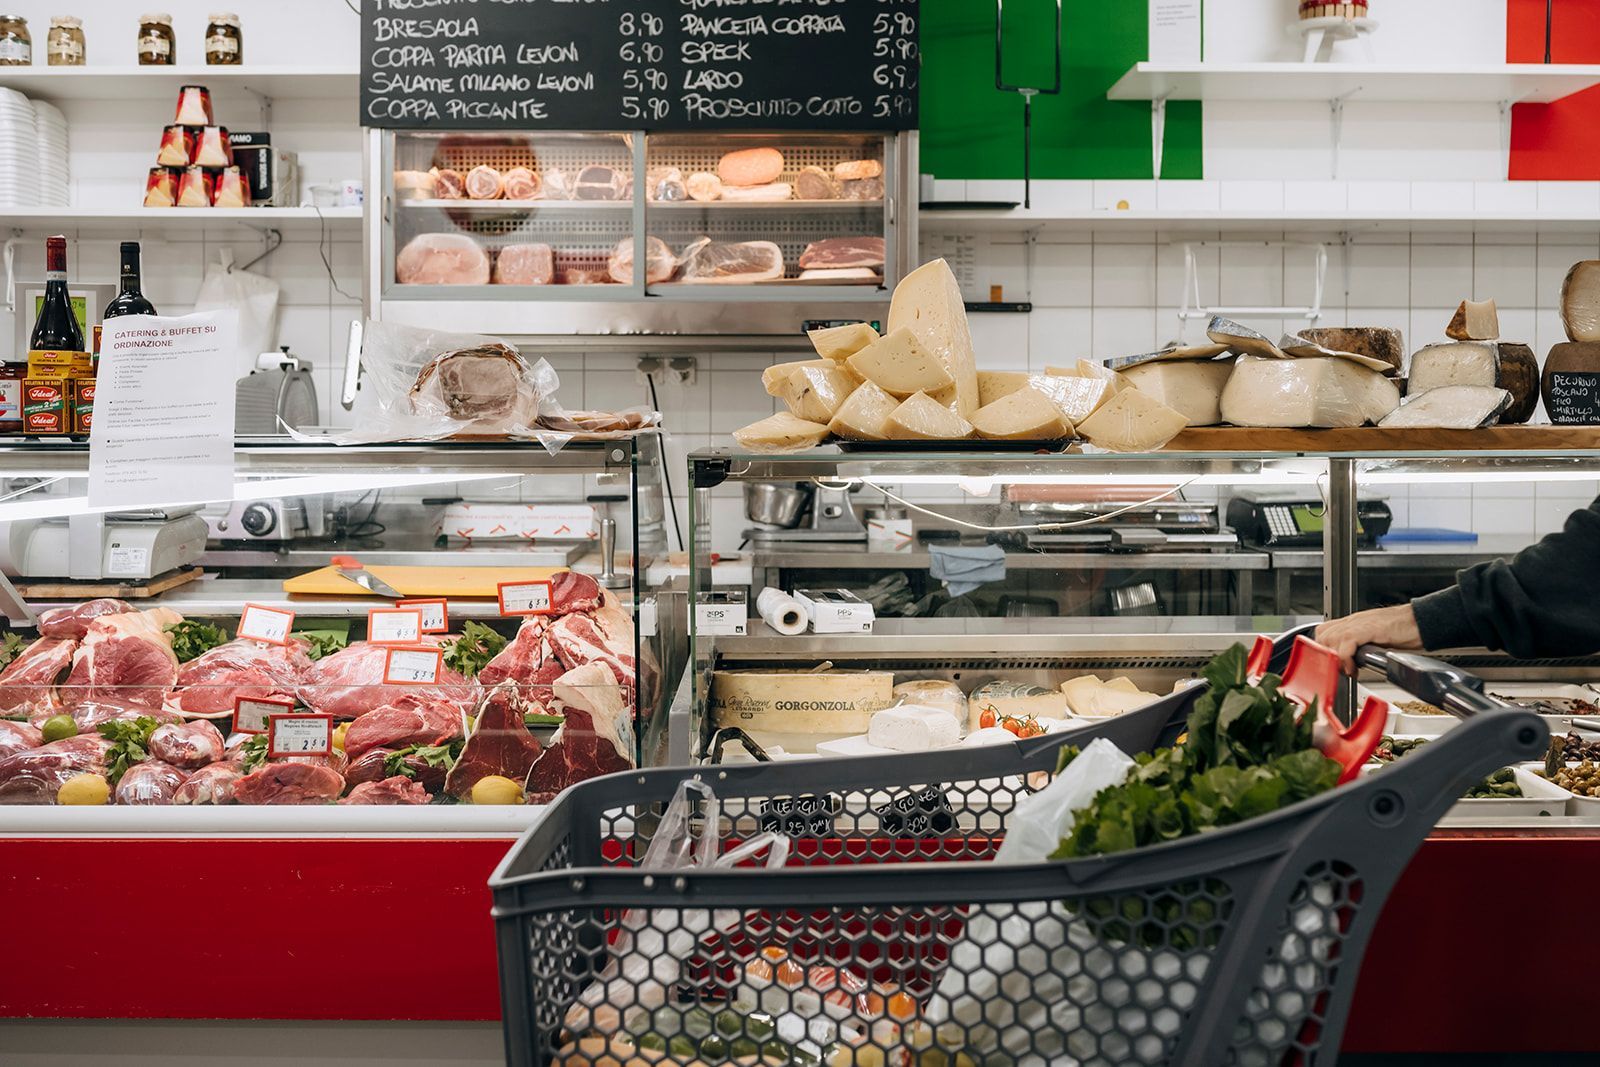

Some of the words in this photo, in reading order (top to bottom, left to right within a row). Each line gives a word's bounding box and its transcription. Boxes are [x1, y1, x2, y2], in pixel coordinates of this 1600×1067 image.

[373, 17, 479, 41] BRESAOLA
[619, 12, 664, 37] 8,90
[680, 14, 768, 38] PANCETTA
[771, 14, 846, 35] COPPATA
[873, 12, 915, 35] 5,90
[371, 46, 436, 68] COPPA
[440, 44, 506, 68] PARMA
[517, 42, 579, 65] LEVONI
[619, 41, 664, 63] 6,90
[681, 40, 751, 64] SPECK
[873, 38, 917, 60] 5,90
[368, 72, 455, 94] SALAME
[460, 73, 530, 92] MILANO
[537, 72, 594, 92] LEVONI
[622, 68, 668, 92] 5,90
[683, 69, 743, 91] LARDO
[368, 97, 440, 121] COPPA
[446, 98, 548, 121] PICCANTE
[621, 96, 670, 120] 5,90
[680, 93, 801, 121] PROSCIUTTO
[806, 95, 862, 117] COTTO
[114, 329, 159, 340] CATERING
[160, 328, 167, 337] &
[170, 326, 202, 337] BUFFET
[205, 325, 217, 334] SU
[113, 340, 173, 350] ORDINAZIONE
[31, 389, 55, 398] Ideal
[32, 416, 56, 424] Ideal
[775, 700, 856, 711] GORGONZOLA
